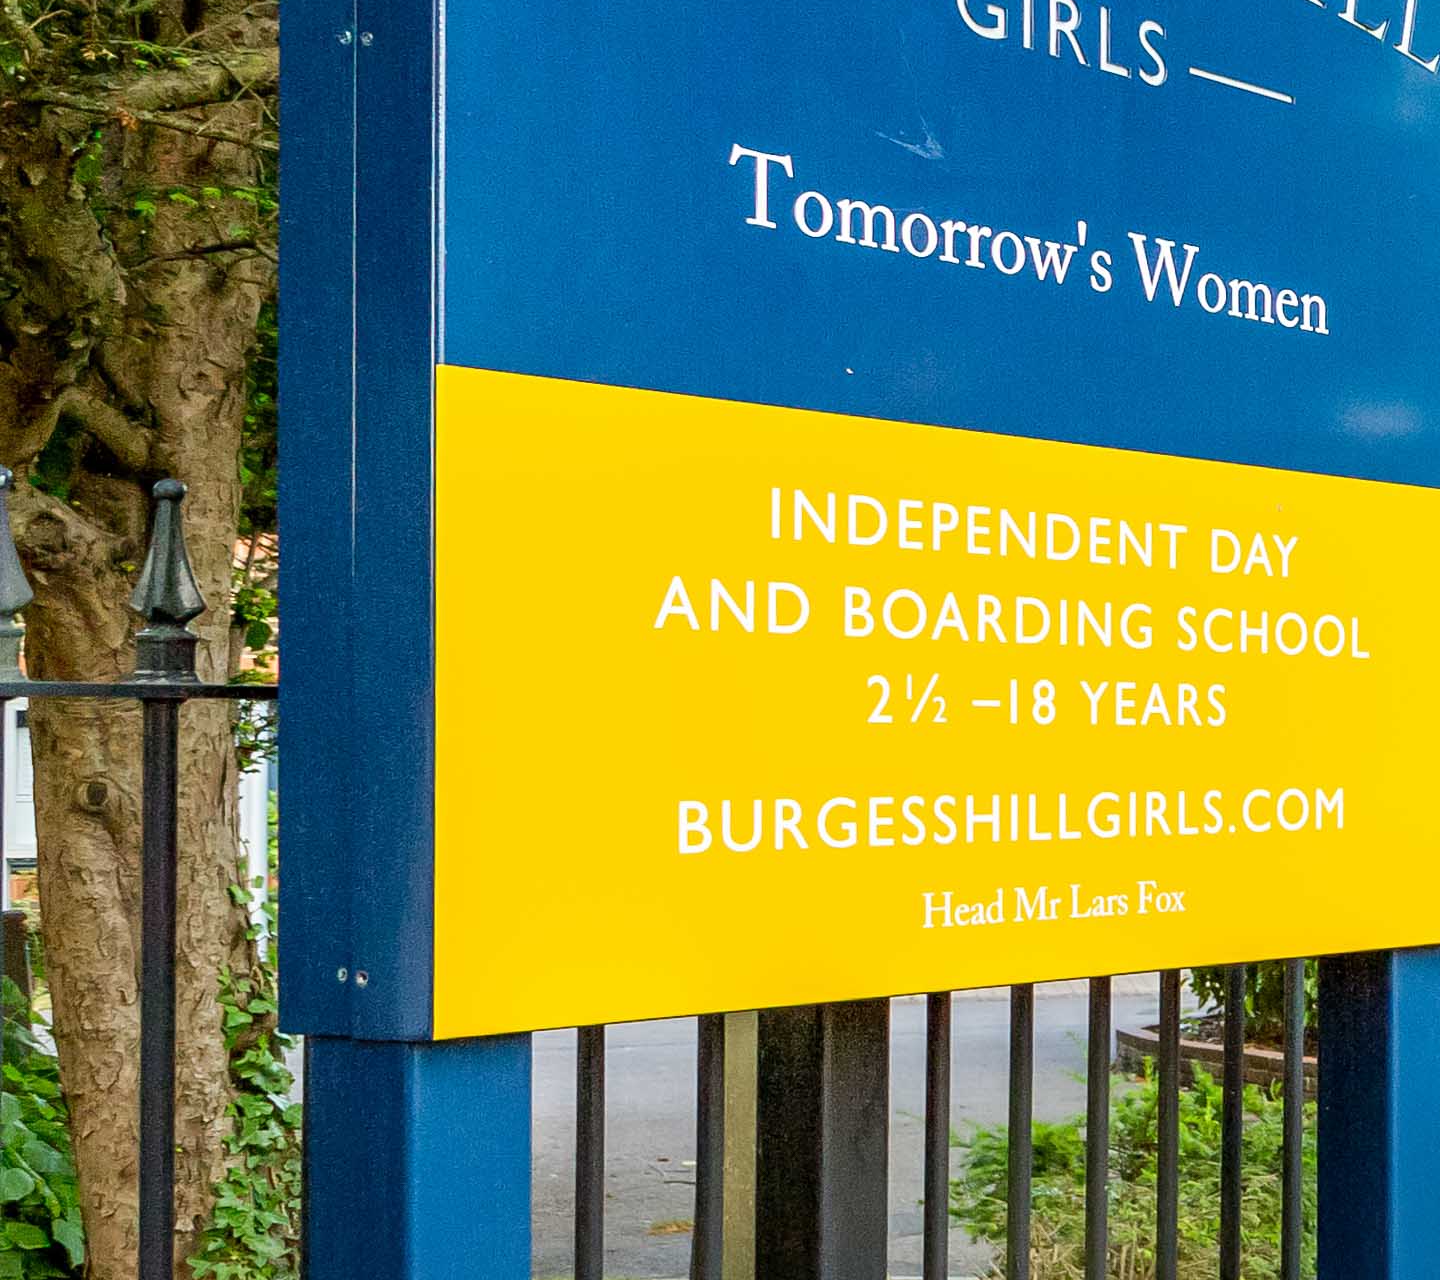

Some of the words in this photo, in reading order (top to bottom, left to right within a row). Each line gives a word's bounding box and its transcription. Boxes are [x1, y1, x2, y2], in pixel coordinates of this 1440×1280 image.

[728, 143, 1114, 293] Tomorrow's
[1126, 231, 1331, 336] Women
[770, 486, 1188, 570] INDEPENDENT
[1210, 528, 1299, 578] DAY
[653, 575, 810, 635] AND
[843, 586, 1154, 650] BOARDING
[1176, 606, 1371, 660] SCHOOL
[1079, 680, 1227, 728] YEARS
[677, 787, 1345, 855] BURGESSHILLGIRLS.COM
[922, 887, 1005, 930] Head
[1013, 884, 1061, 923] Mr
[1069, 881, 1130, 919] Lars
[1136, 878, 1187, 915] Fox
